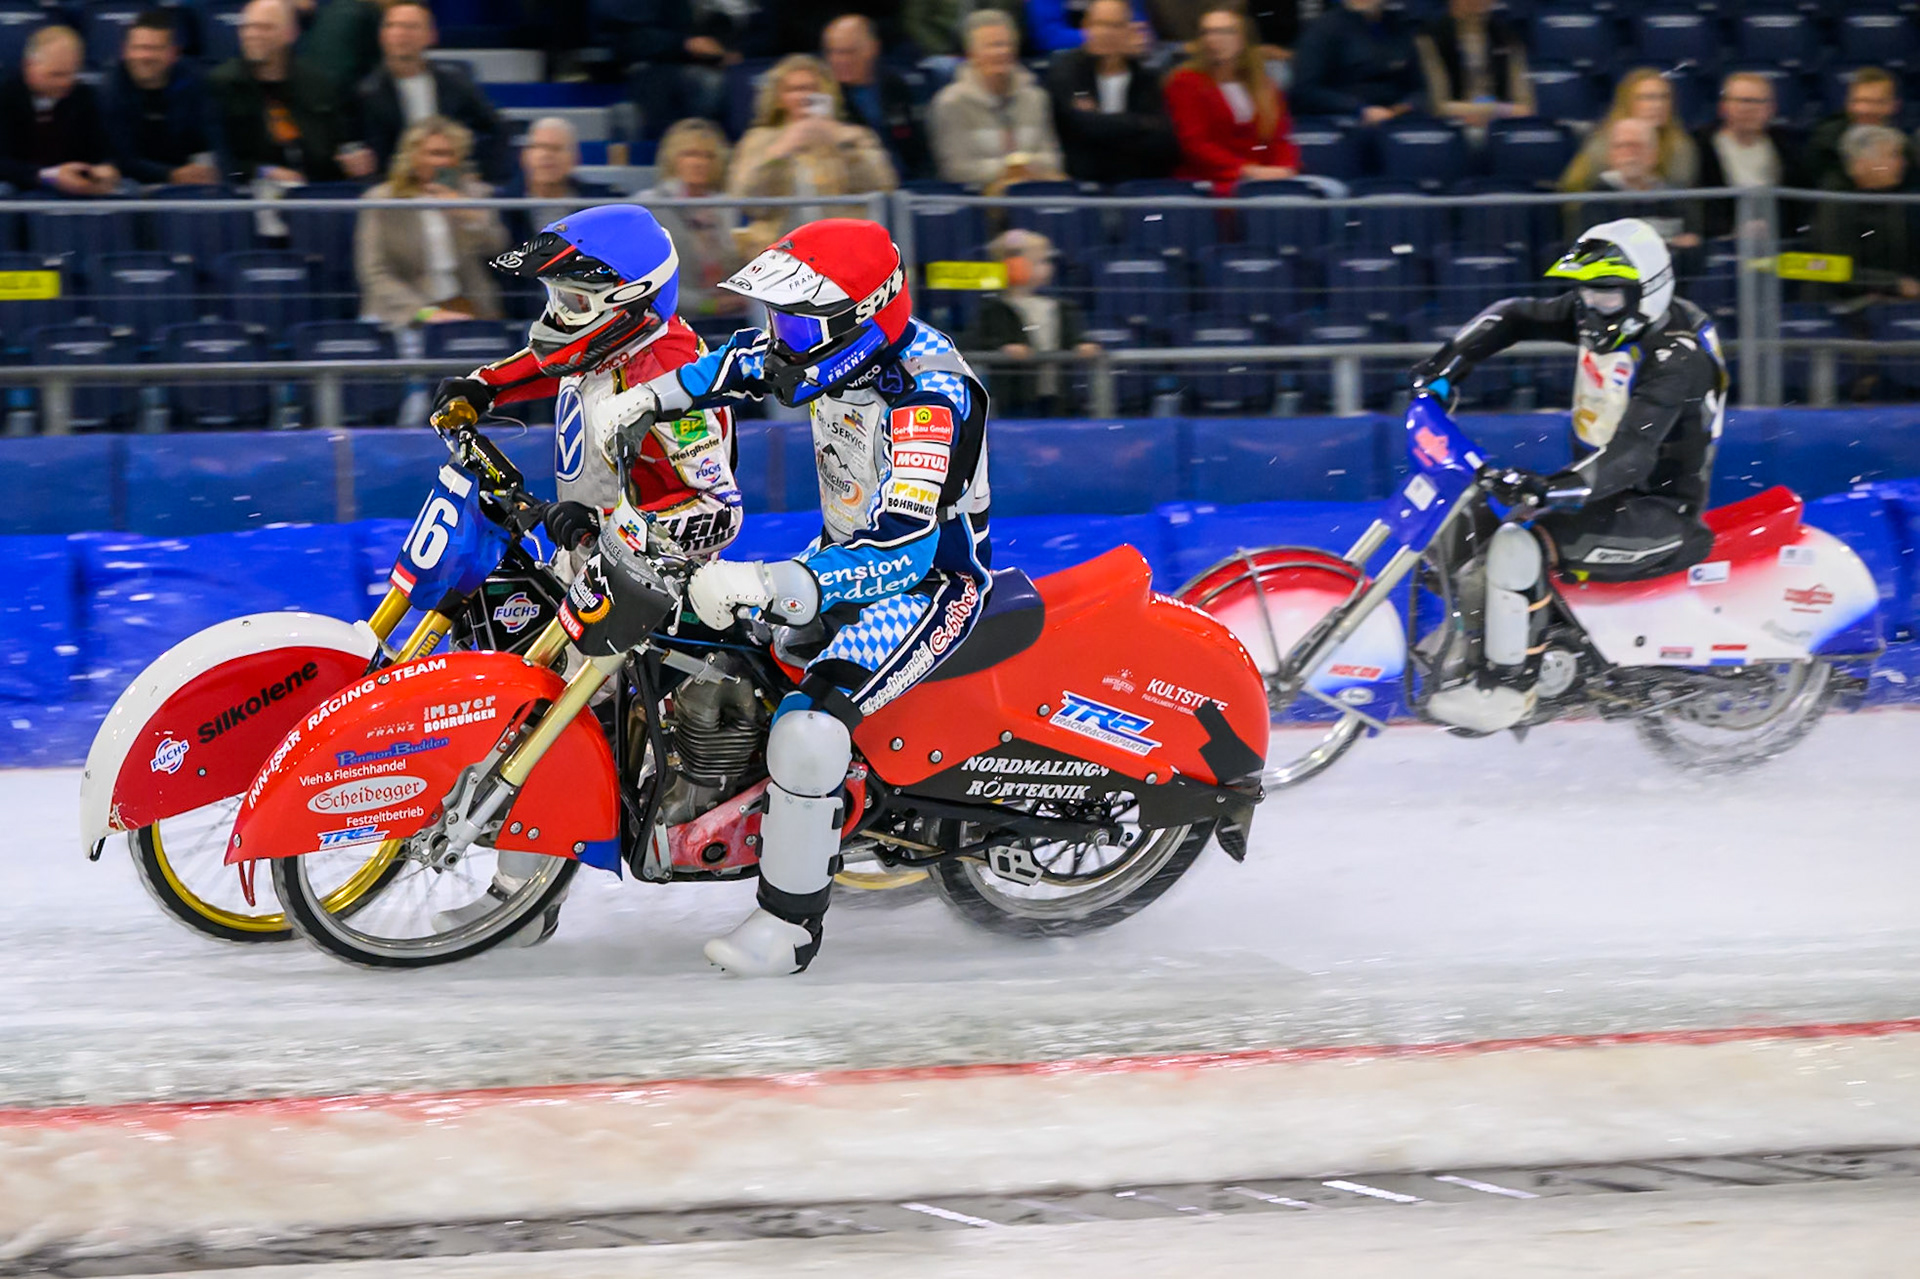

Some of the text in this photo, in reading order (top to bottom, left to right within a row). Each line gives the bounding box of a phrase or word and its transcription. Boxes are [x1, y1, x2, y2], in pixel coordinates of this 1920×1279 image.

[827, 350, 867, 383] FRANZ
[895, 452, 946, 471] MOTUL
[812, 554, 913, 587] ension
[822, 571, 920, 605] dden
[495, 605, 539, 618] FUCHS
[196, 661, 319, 745] Silkolene
[307, 678, 376, 731] RACING
[391, 658, 447, 683] TEAM
[430, 695, 496, 720] Mayer
[423, 707, 497, 734] BOHRUNGEN
[1051, 714, 1150, 755] TRACKRACINGPARTS
[152, 741, 188, 770] FUCHS
[299, 758, 407, 787] Vieh & Fleischhandel
[314, 780, 420, 811] Scheidegger
[346, 805, 425, 828] Festzeltbetrieb
